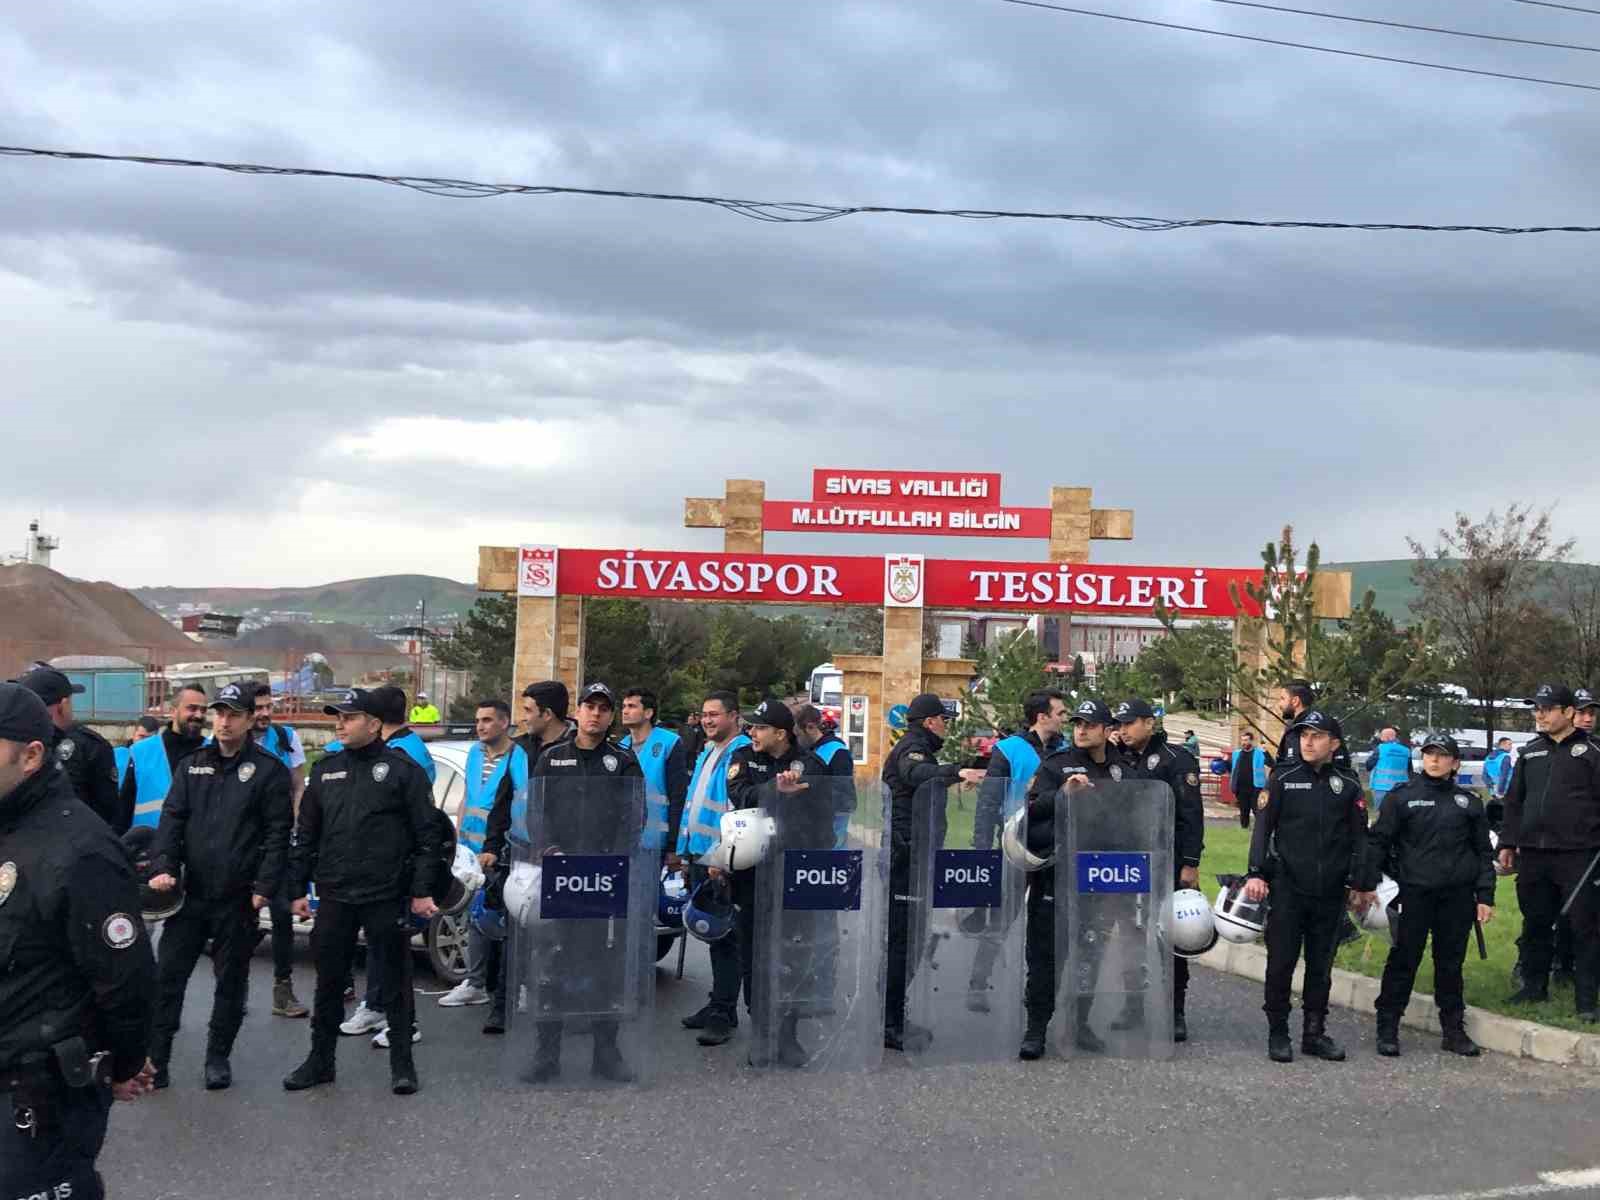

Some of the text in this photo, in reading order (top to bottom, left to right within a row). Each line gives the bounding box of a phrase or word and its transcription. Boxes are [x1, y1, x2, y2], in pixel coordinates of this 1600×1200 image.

[825, 475, 891, 496] SİVAS
[791, 506, 1021, 530] M.LÜTFULLAH BİLGİN
[597, 551, 842, 596] SİVASSPOR
[969, 564, 1207, 608] TESİSLERİ
[555, 872, 613, 892] POLİS
[796, 866, 848, 885] POLİS
[944, 865, 990, 883] POLİS
[1088, 864, 1141, 883] POLİS
